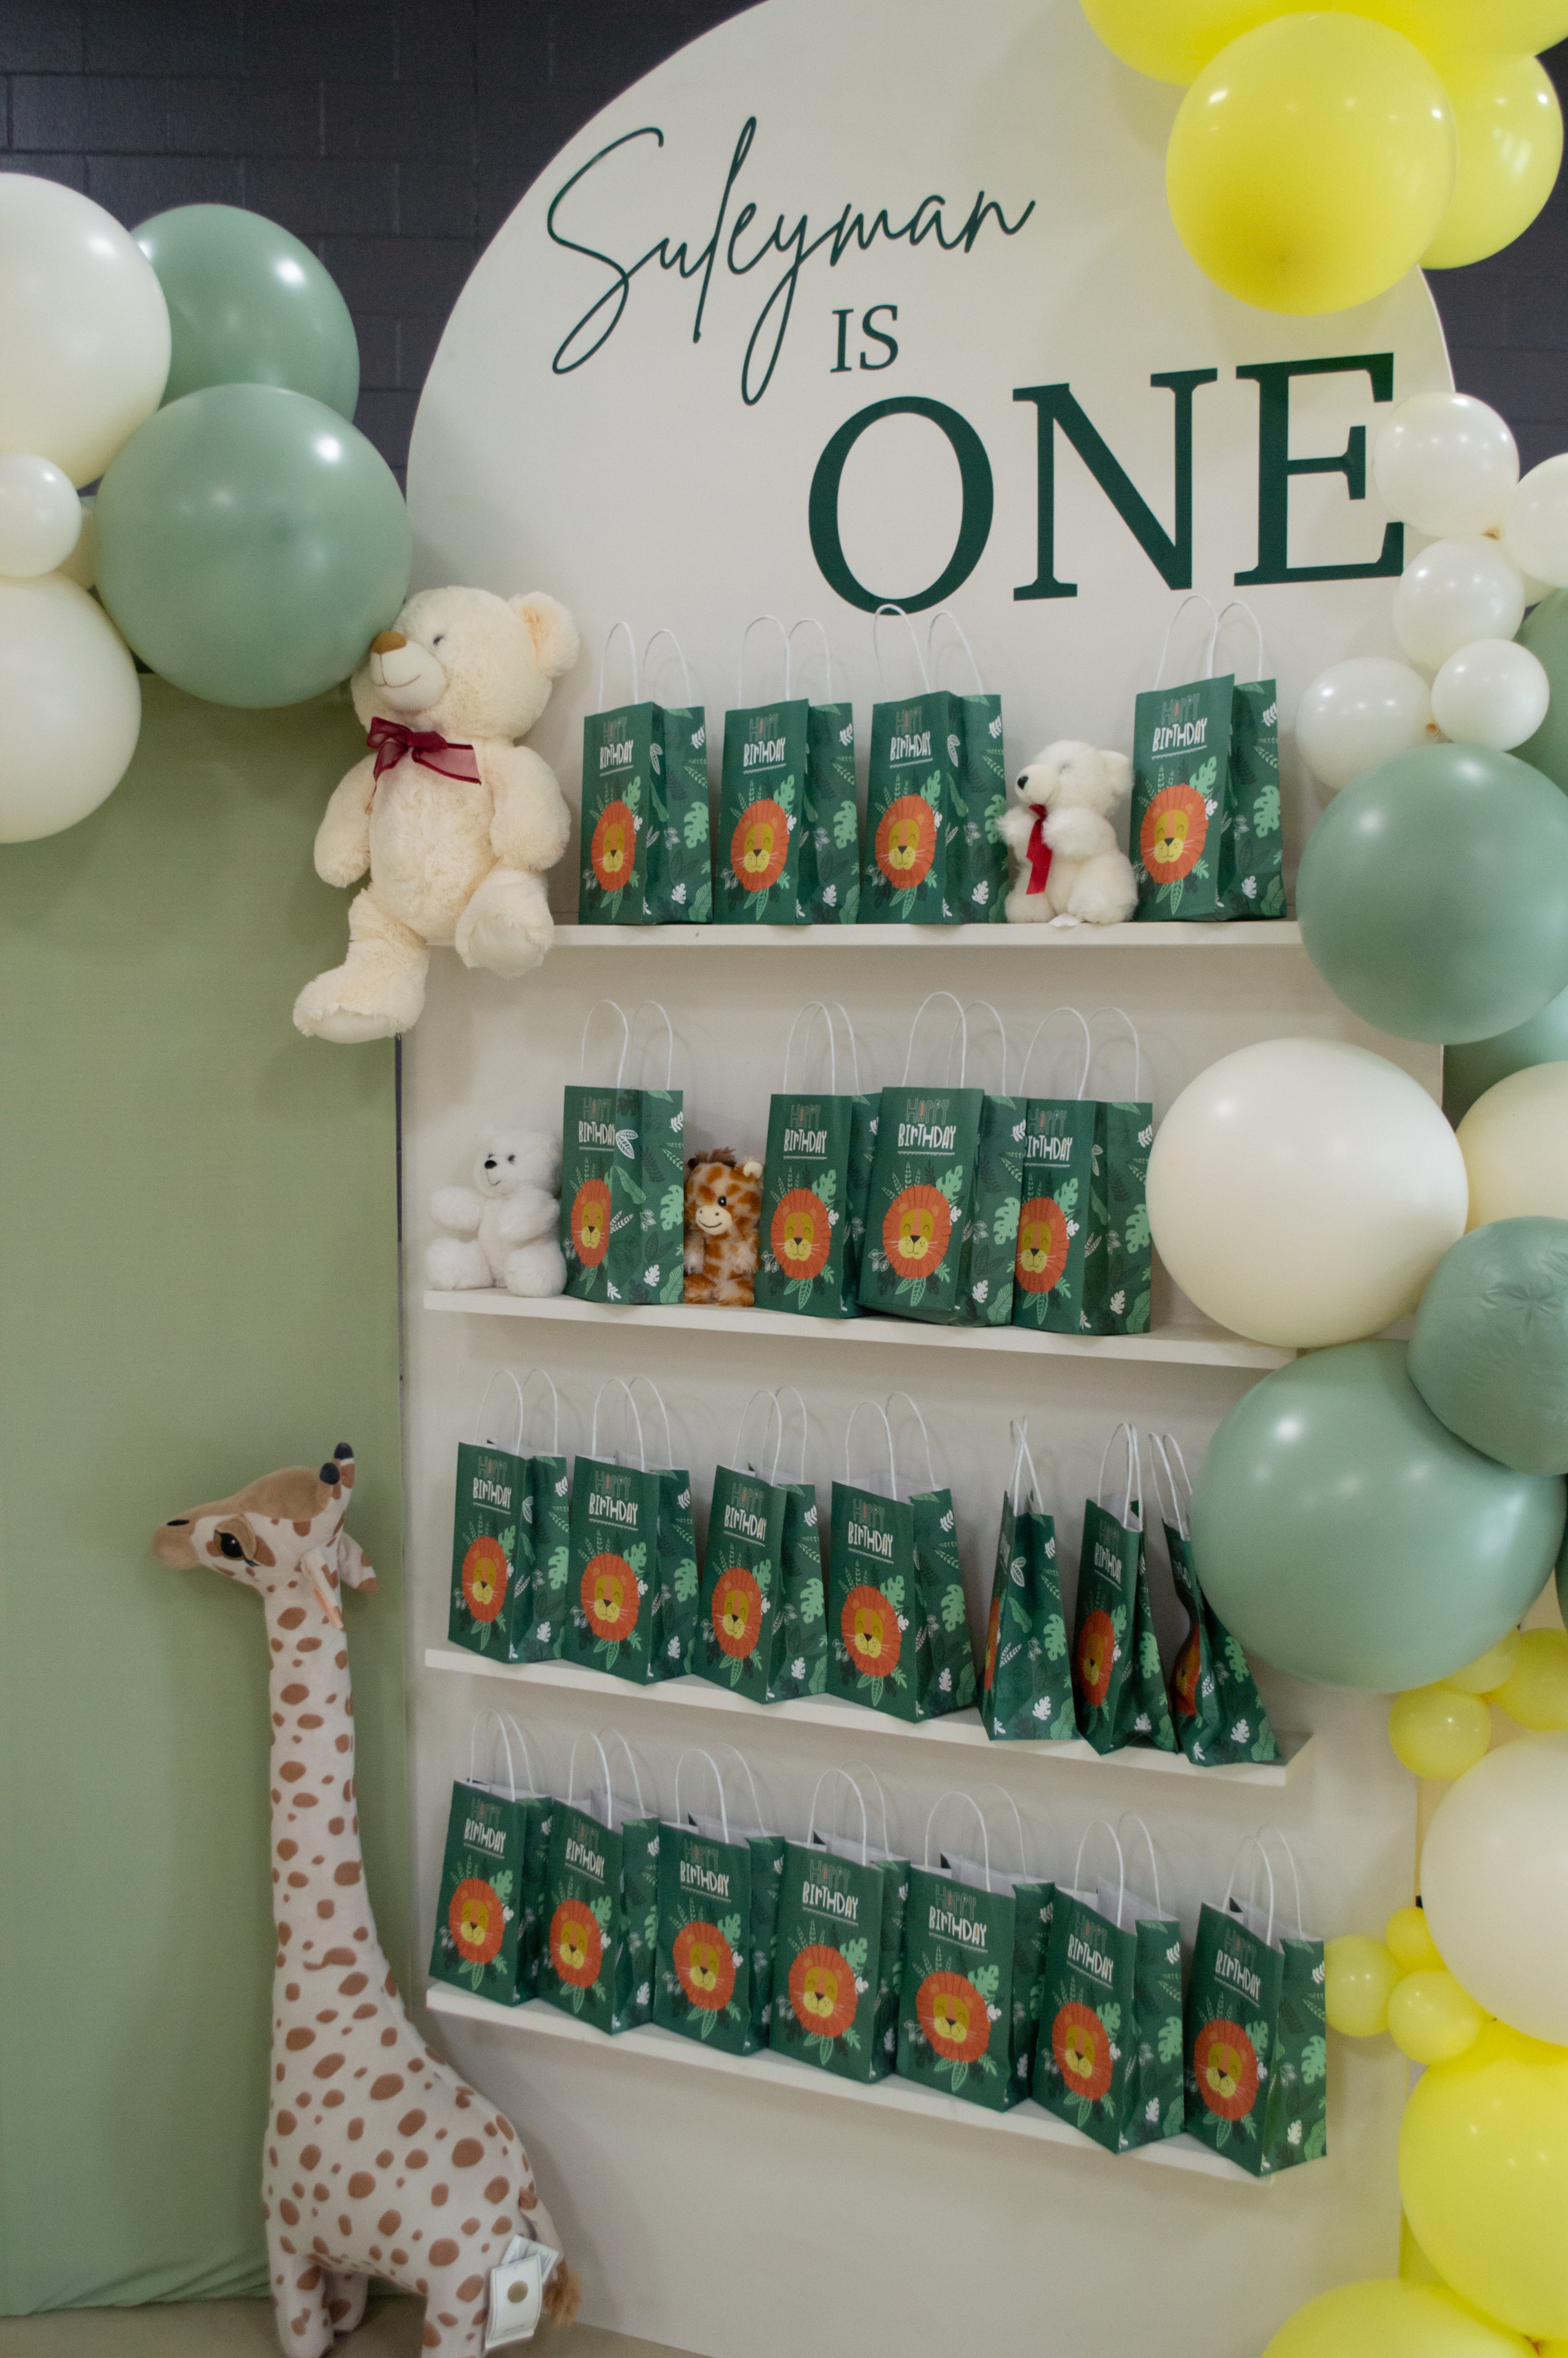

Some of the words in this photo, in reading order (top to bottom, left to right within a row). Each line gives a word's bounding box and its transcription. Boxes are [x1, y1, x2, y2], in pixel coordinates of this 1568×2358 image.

[547, 116, 1036, 405] Suleyman
[830, 304, 900, 374] IS
[808, 352, 1405, 615] ONE
